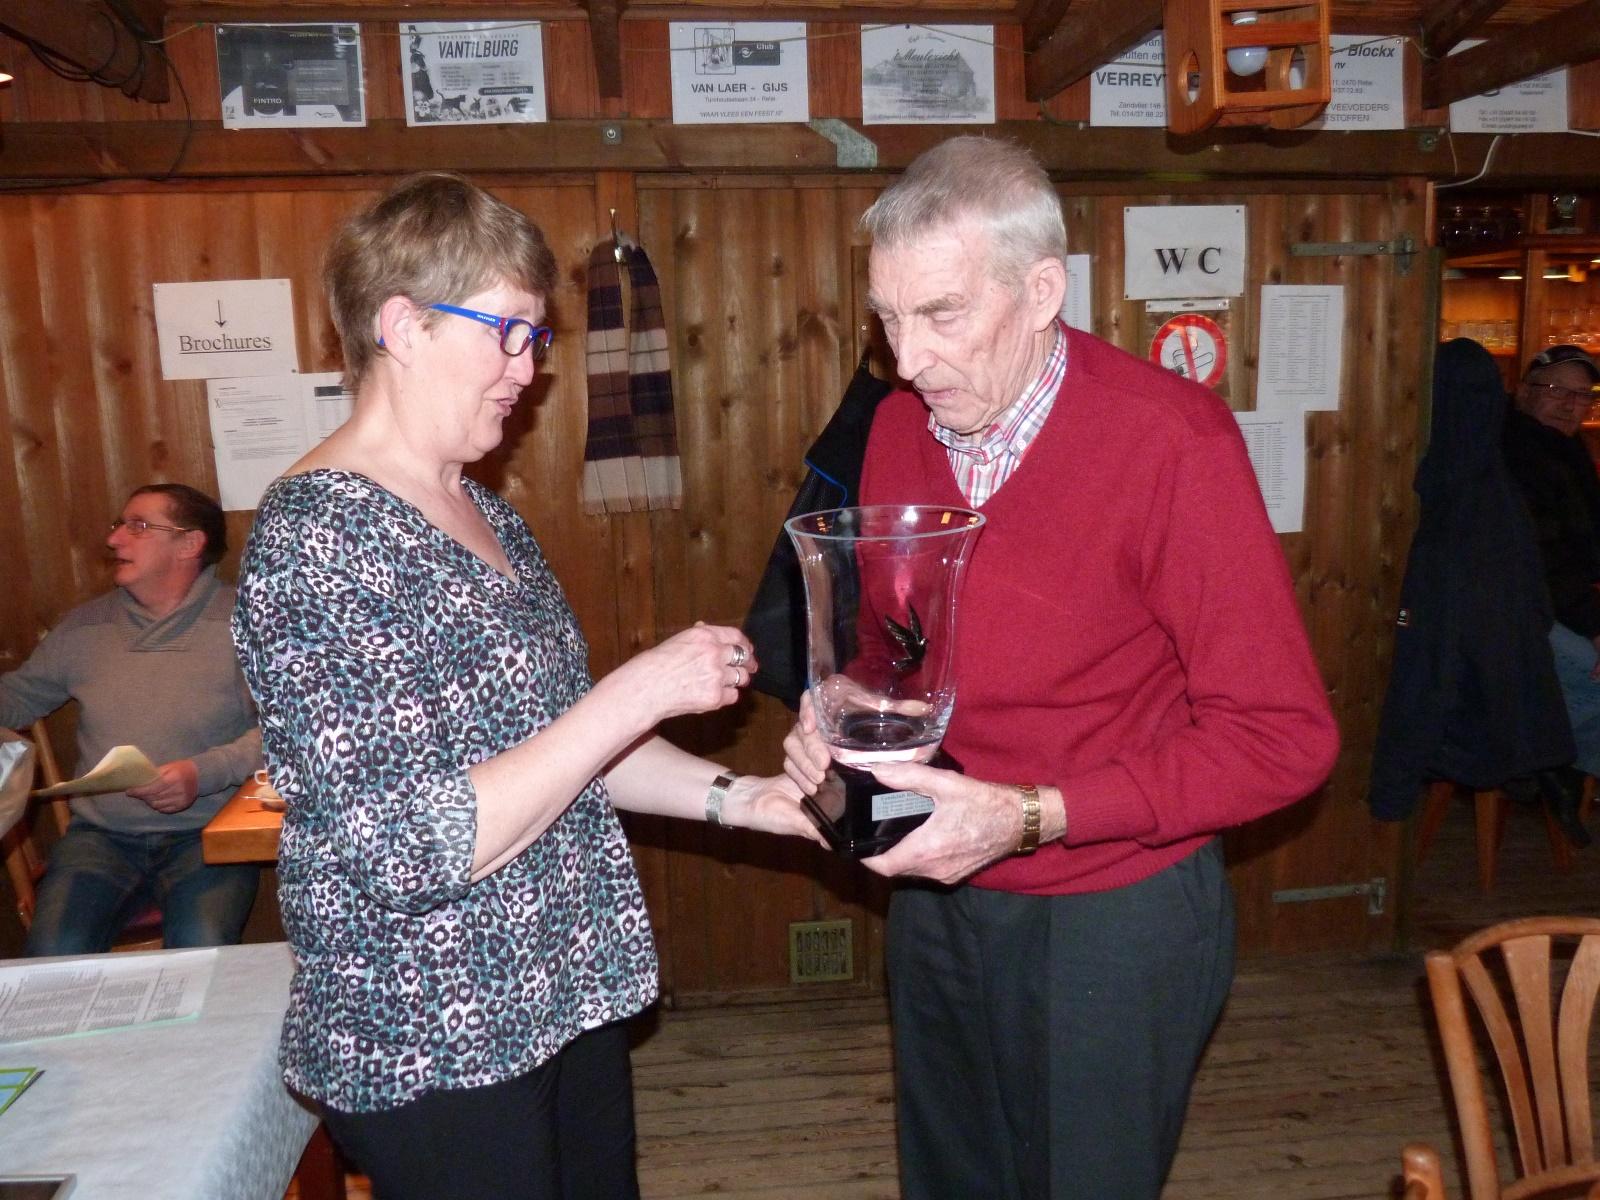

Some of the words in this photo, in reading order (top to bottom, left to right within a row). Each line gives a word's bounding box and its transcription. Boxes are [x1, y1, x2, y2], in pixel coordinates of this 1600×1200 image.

[756, 42, 775, 50] Club
[1334, 61, 1346, 69] nv
[691, 83, 714, 93] VAN
[718, 83, 747, 93] LAER
[762, 82, 788, 92] GIJS
[177, 333, 272, 352] Brochures
